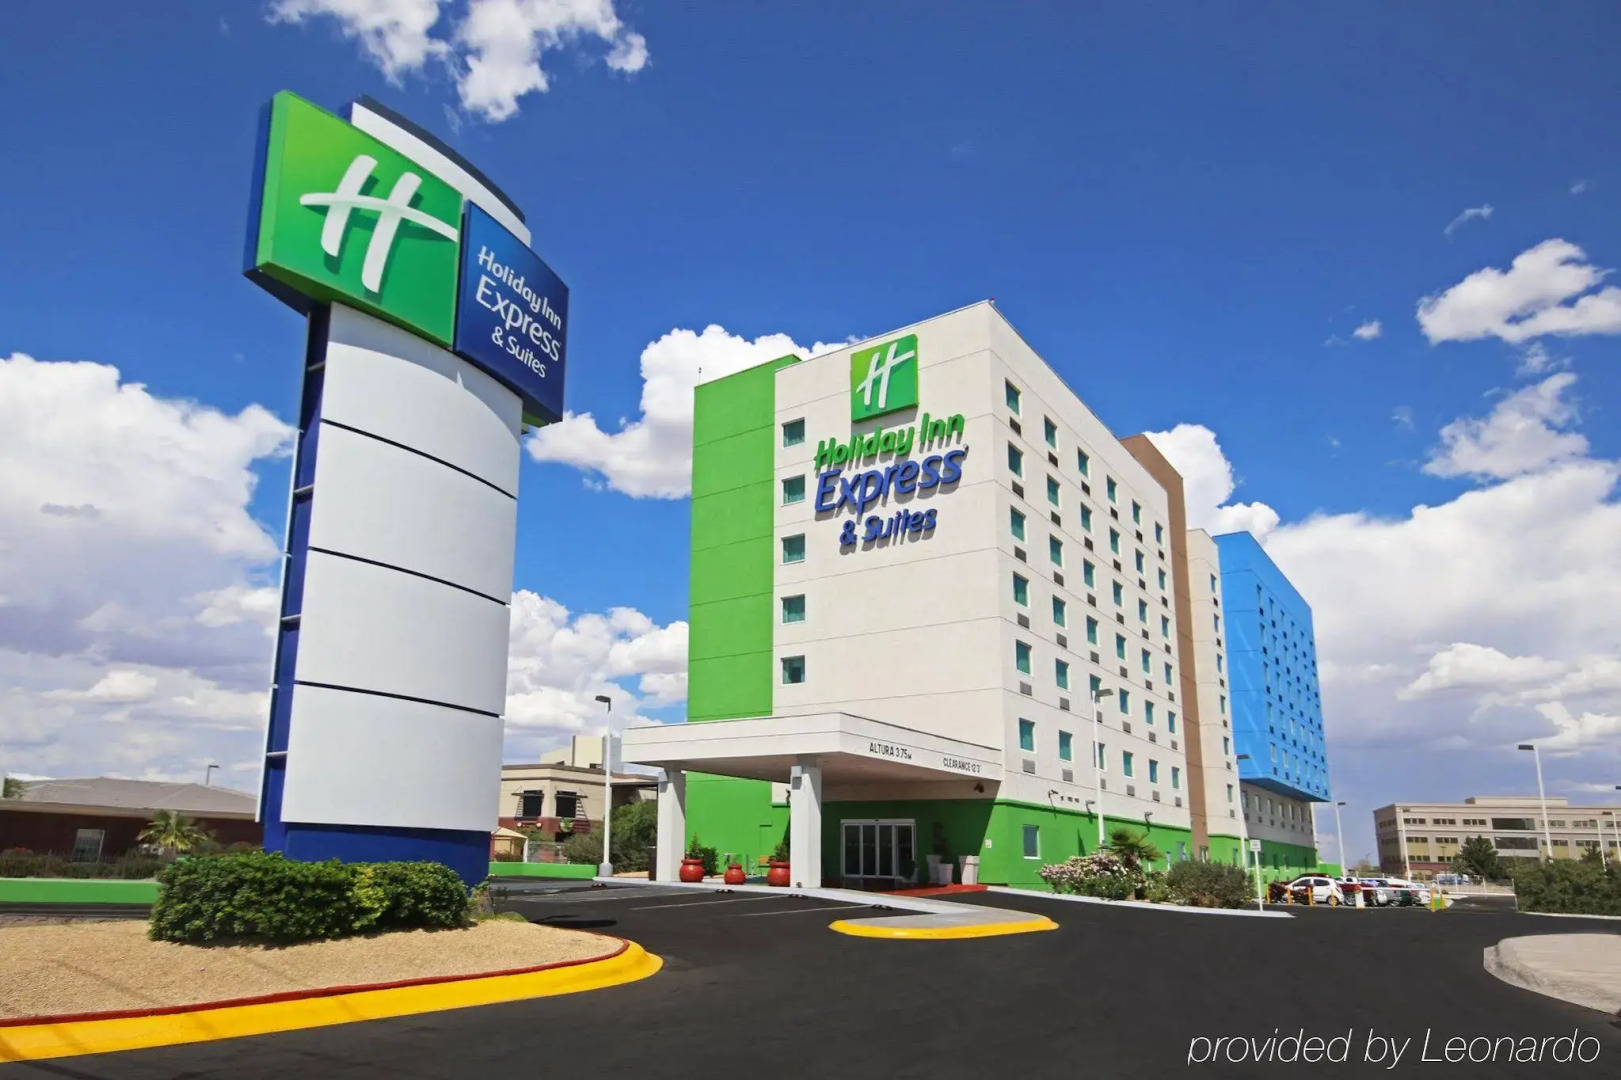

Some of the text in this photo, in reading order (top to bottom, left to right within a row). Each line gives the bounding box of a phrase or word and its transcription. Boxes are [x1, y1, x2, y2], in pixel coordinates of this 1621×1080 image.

[478, 246, 562, 331] Holiday Inn
[476, 274, 560, 362] Express
[491, 326, 547, 378] & Suites
[814, 412, 965, 470] Holiday Inn
[814, 449, 966, 515] Express
[839, 508, 938, 546] & Suites
[869, 742, 895, 757] ALTURA
[943, 757, 971, 771] CLEARANCE
